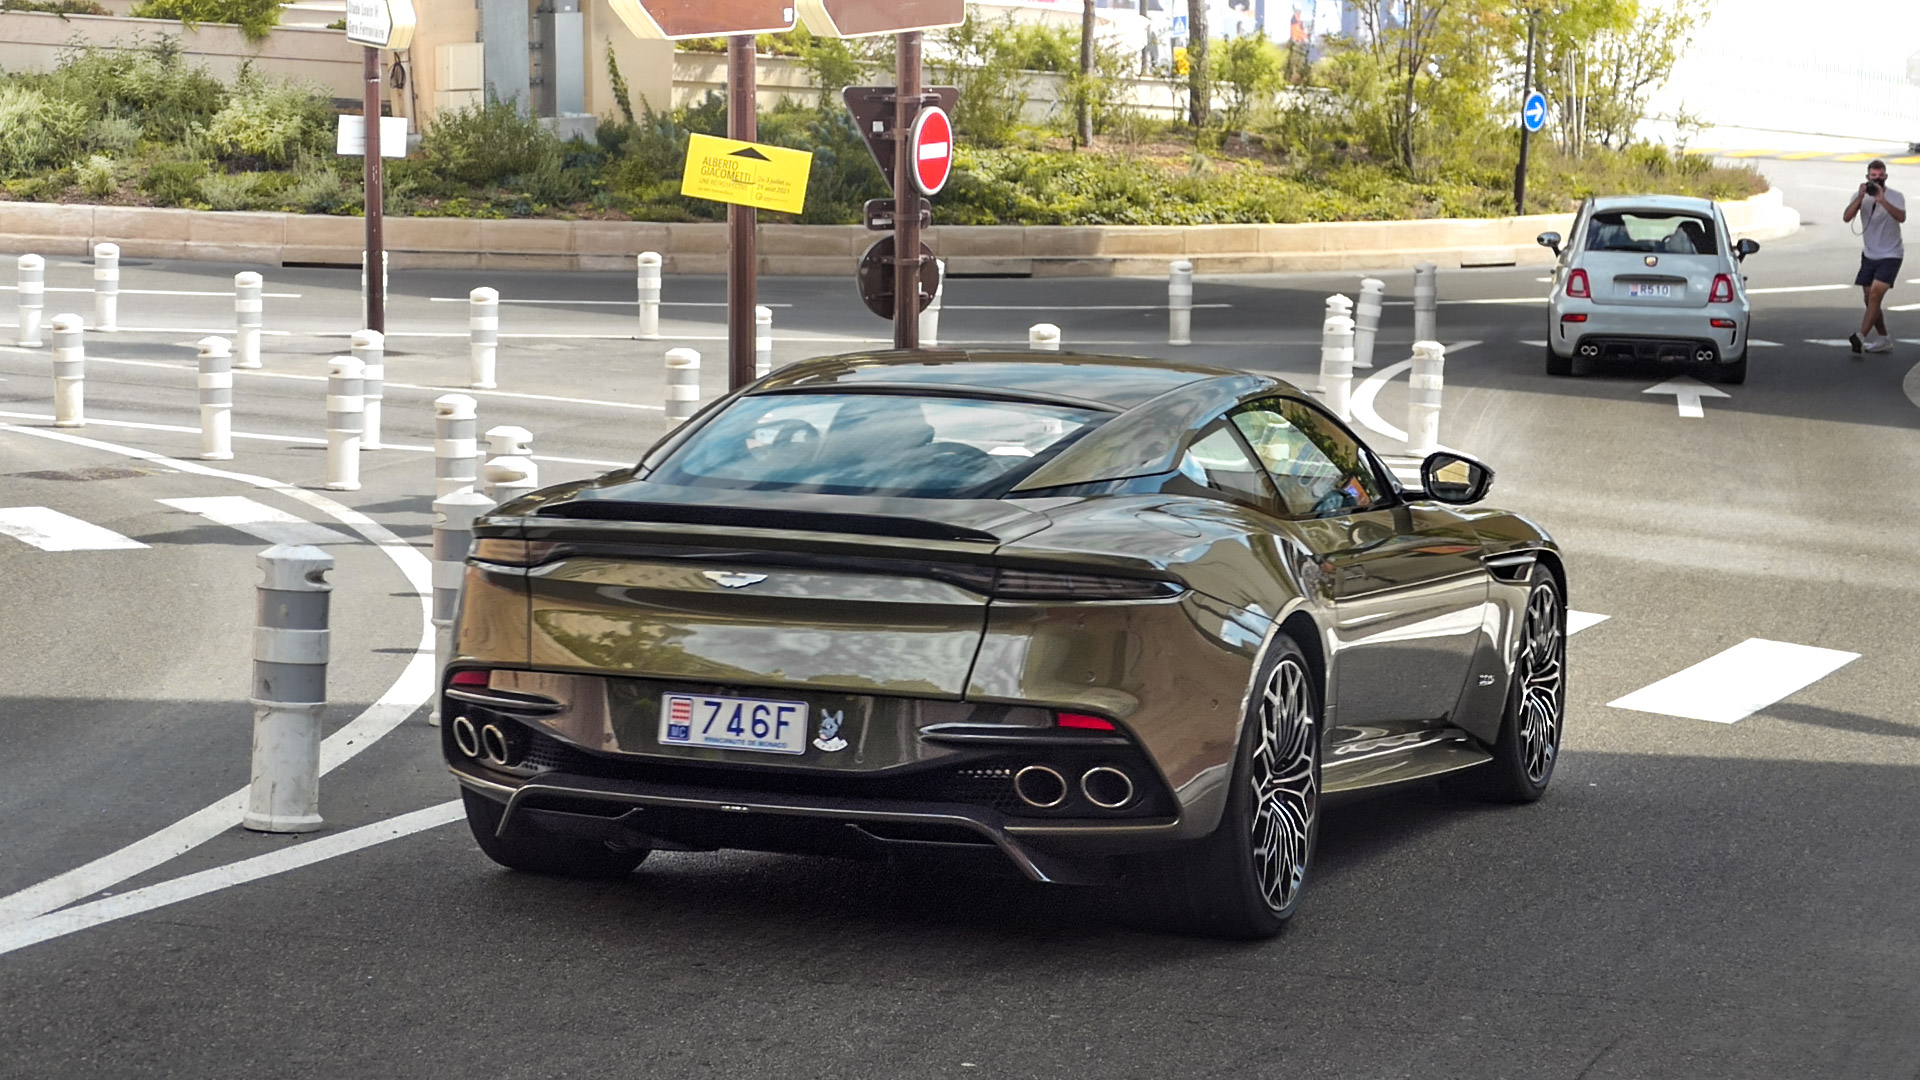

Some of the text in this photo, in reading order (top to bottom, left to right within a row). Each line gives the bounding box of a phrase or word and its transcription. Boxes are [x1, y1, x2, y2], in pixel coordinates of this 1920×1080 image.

[348, 20, 358, 34] Gare
[702, 156, 739, 171] ALBERTO
[700, 166, 751, 182] GIACOMETTI
[770, 177, 785, 186] juillet
[776, 187, 790, 195] 2021
[1640, 284, 1669, 295] R510
[702, 701, 796, 740] 746F
[670, 726, 687, 738] MC
[758, 740, 788, 749] MONACO
